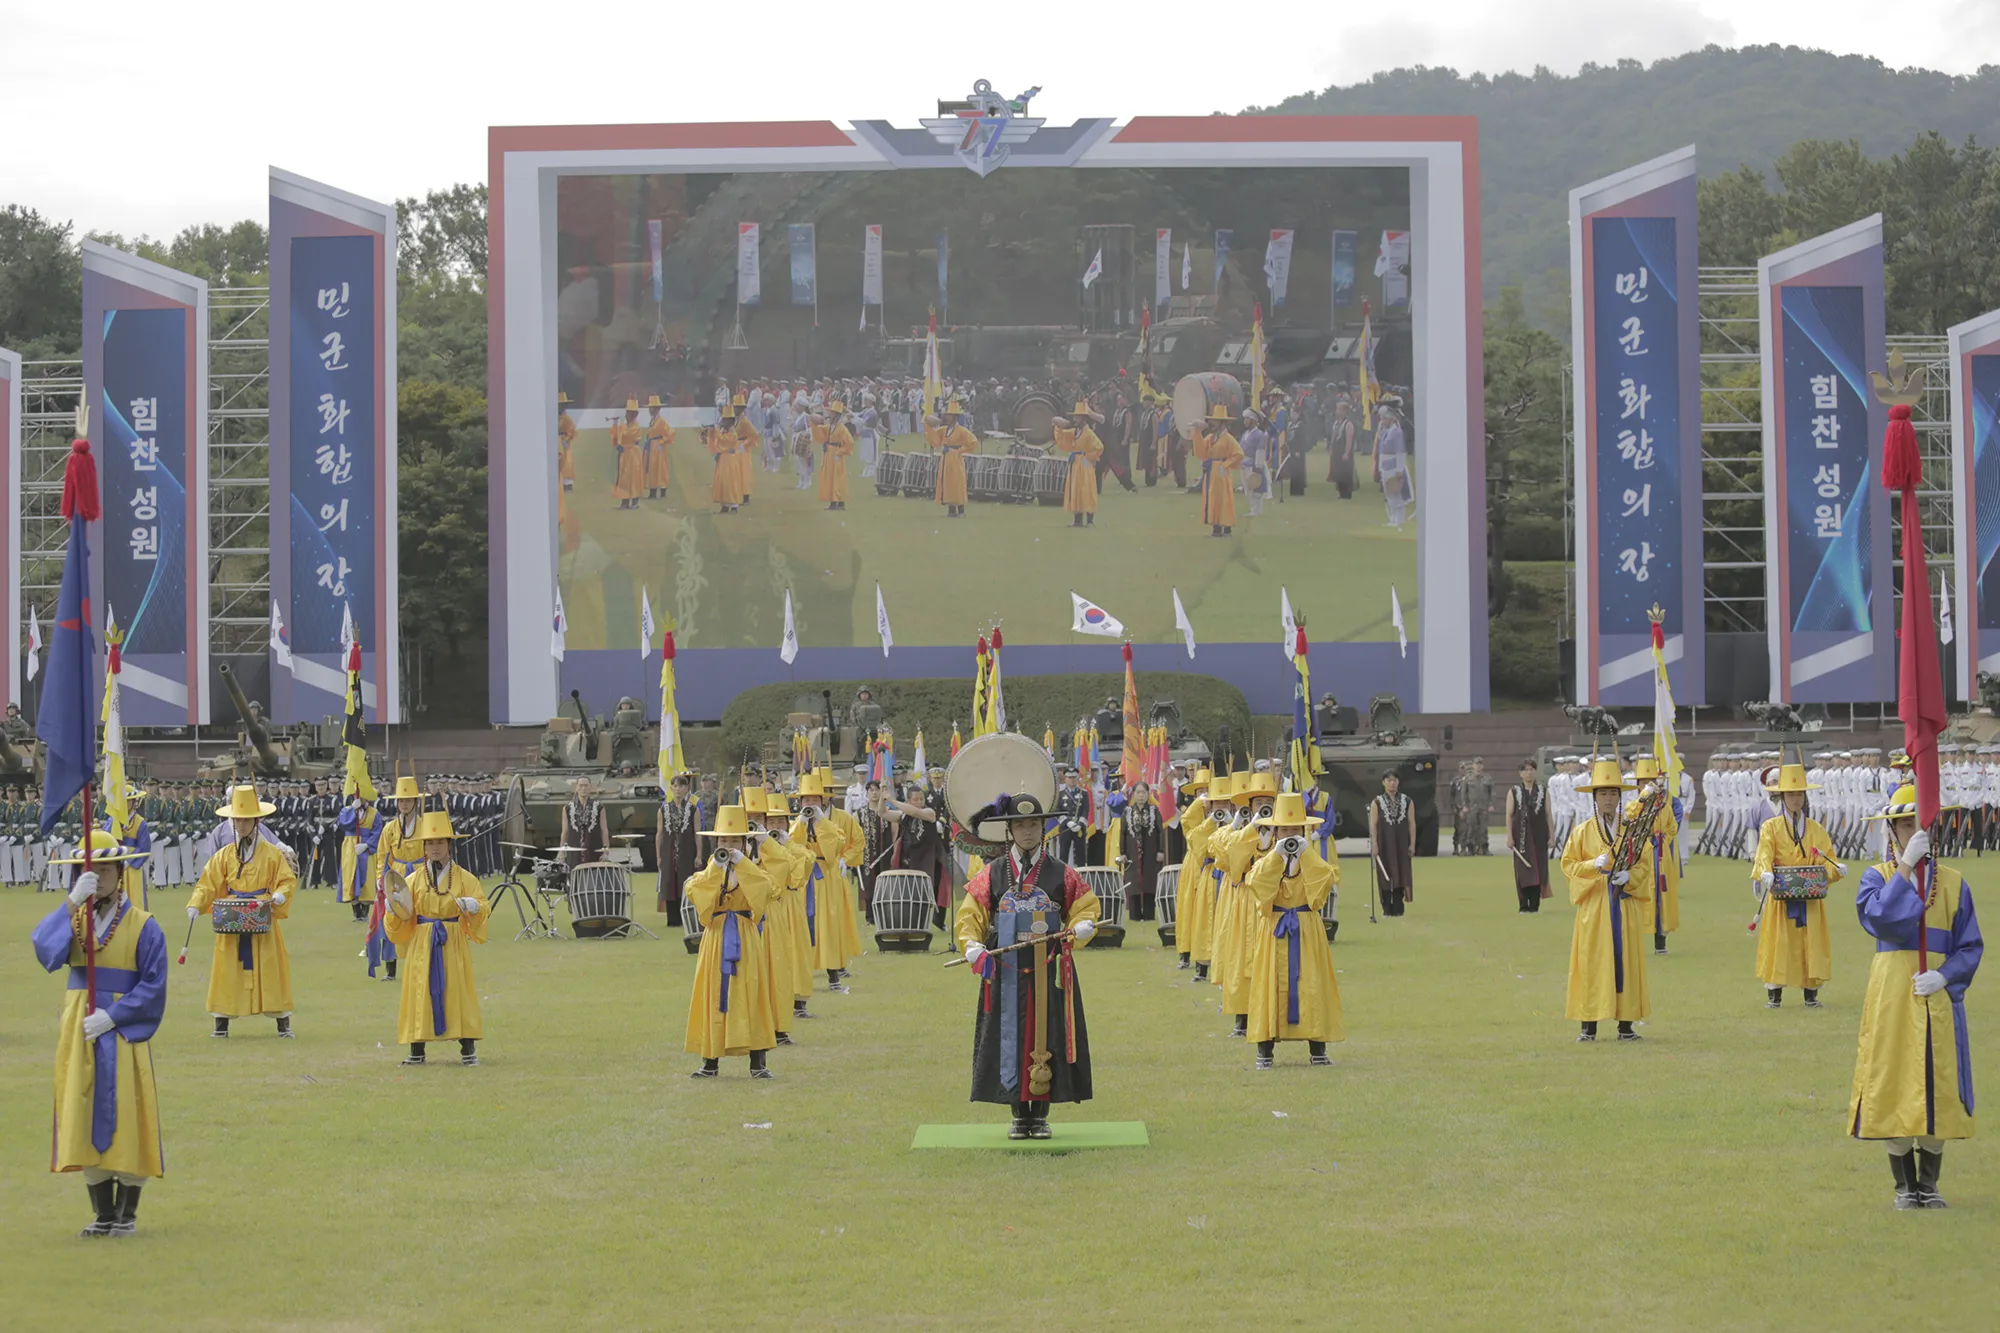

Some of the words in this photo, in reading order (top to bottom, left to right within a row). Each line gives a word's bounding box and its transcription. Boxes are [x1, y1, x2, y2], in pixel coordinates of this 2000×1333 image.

[317, 281, 350, 371] 민군
[1615, 266, 1649, 356] 민군
[129, 397, 160, 471] 힘찬
[315, 393, 353, 485] 화합
[1617, 378, 1655, 471] 화합
[1809, 374, 1841, 449] 힘찬
[129, 486, 159, 560] 성원
[318, 498, 350, 532] 의
[1620, 483, 1652, 517] 의
[1812, 463, 1843, 538] 성원
[316, 556, 353, 597] 장
[1619, 541, 1656, 582] 장
